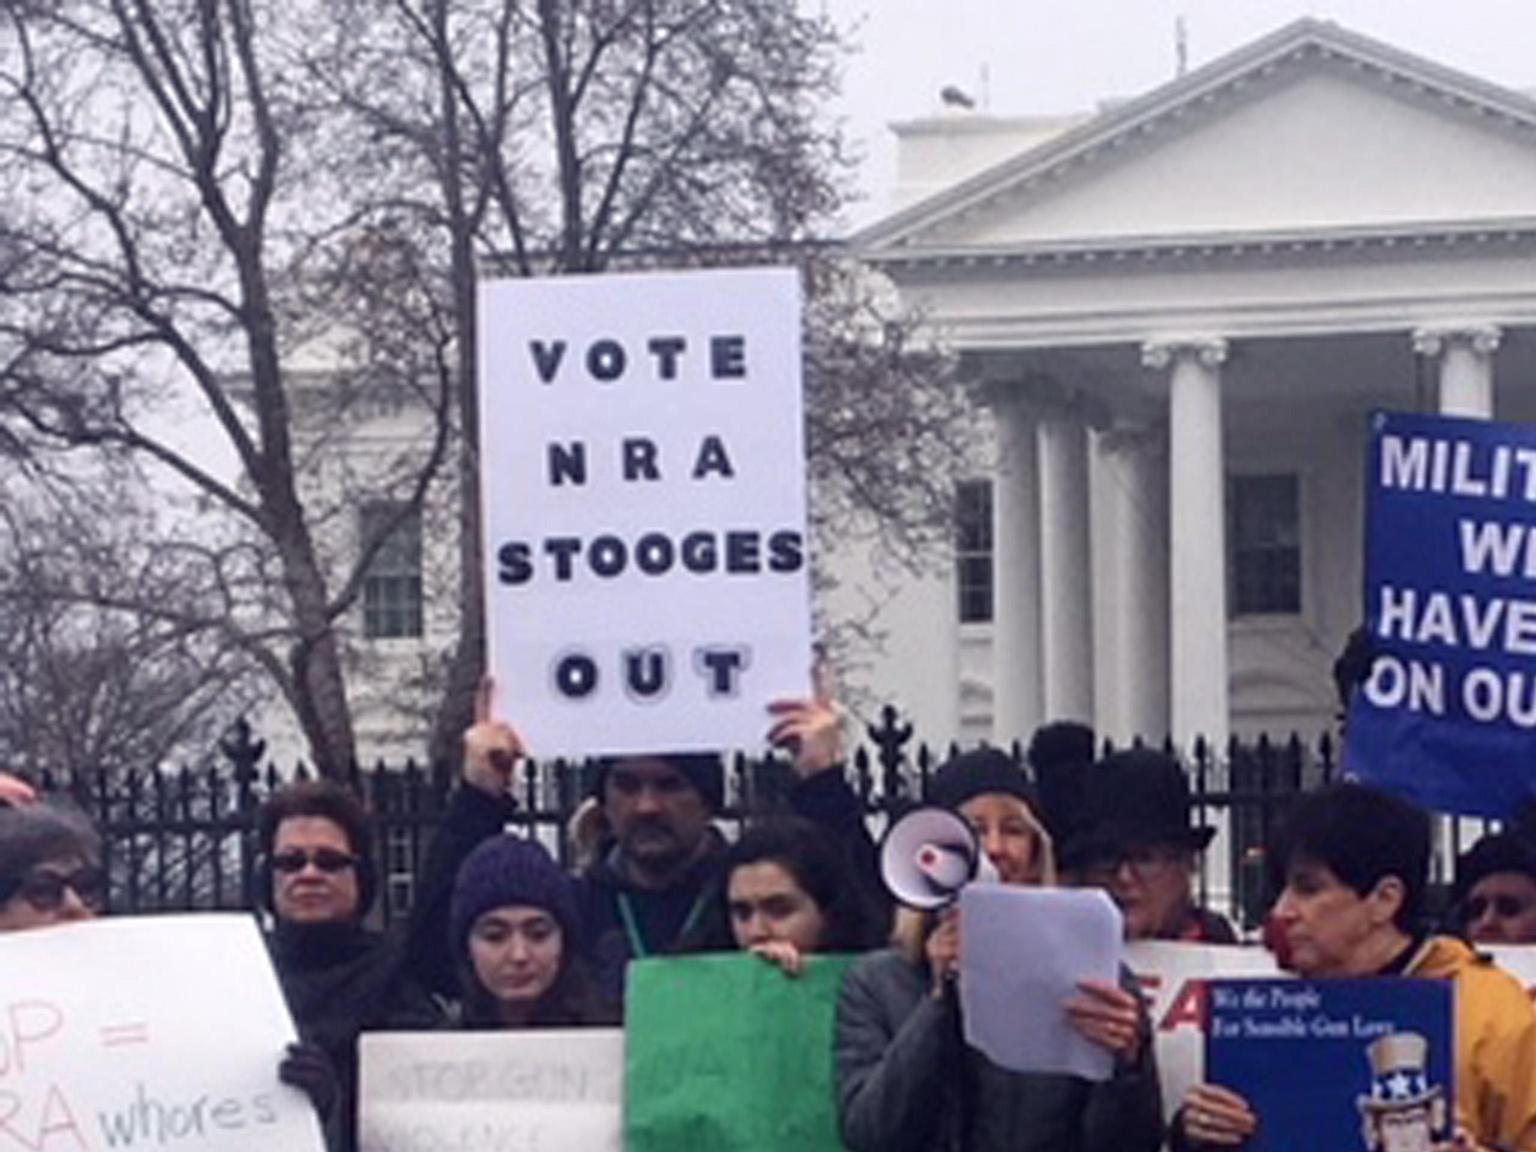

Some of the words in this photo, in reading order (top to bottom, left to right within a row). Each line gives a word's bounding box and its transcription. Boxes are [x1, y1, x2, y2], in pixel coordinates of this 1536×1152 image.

[529, 335, 748, 385] VOTE
[547, 434, 735, 487] NRA
[497, 529, 805, 587] STOOGES
[552, 646, 748, 701] OUT
[1363, 656, 1446, 715] ON
[1309, 1013, 1351, 1038] Gun
[99, 1083, 280, 1149] whores
